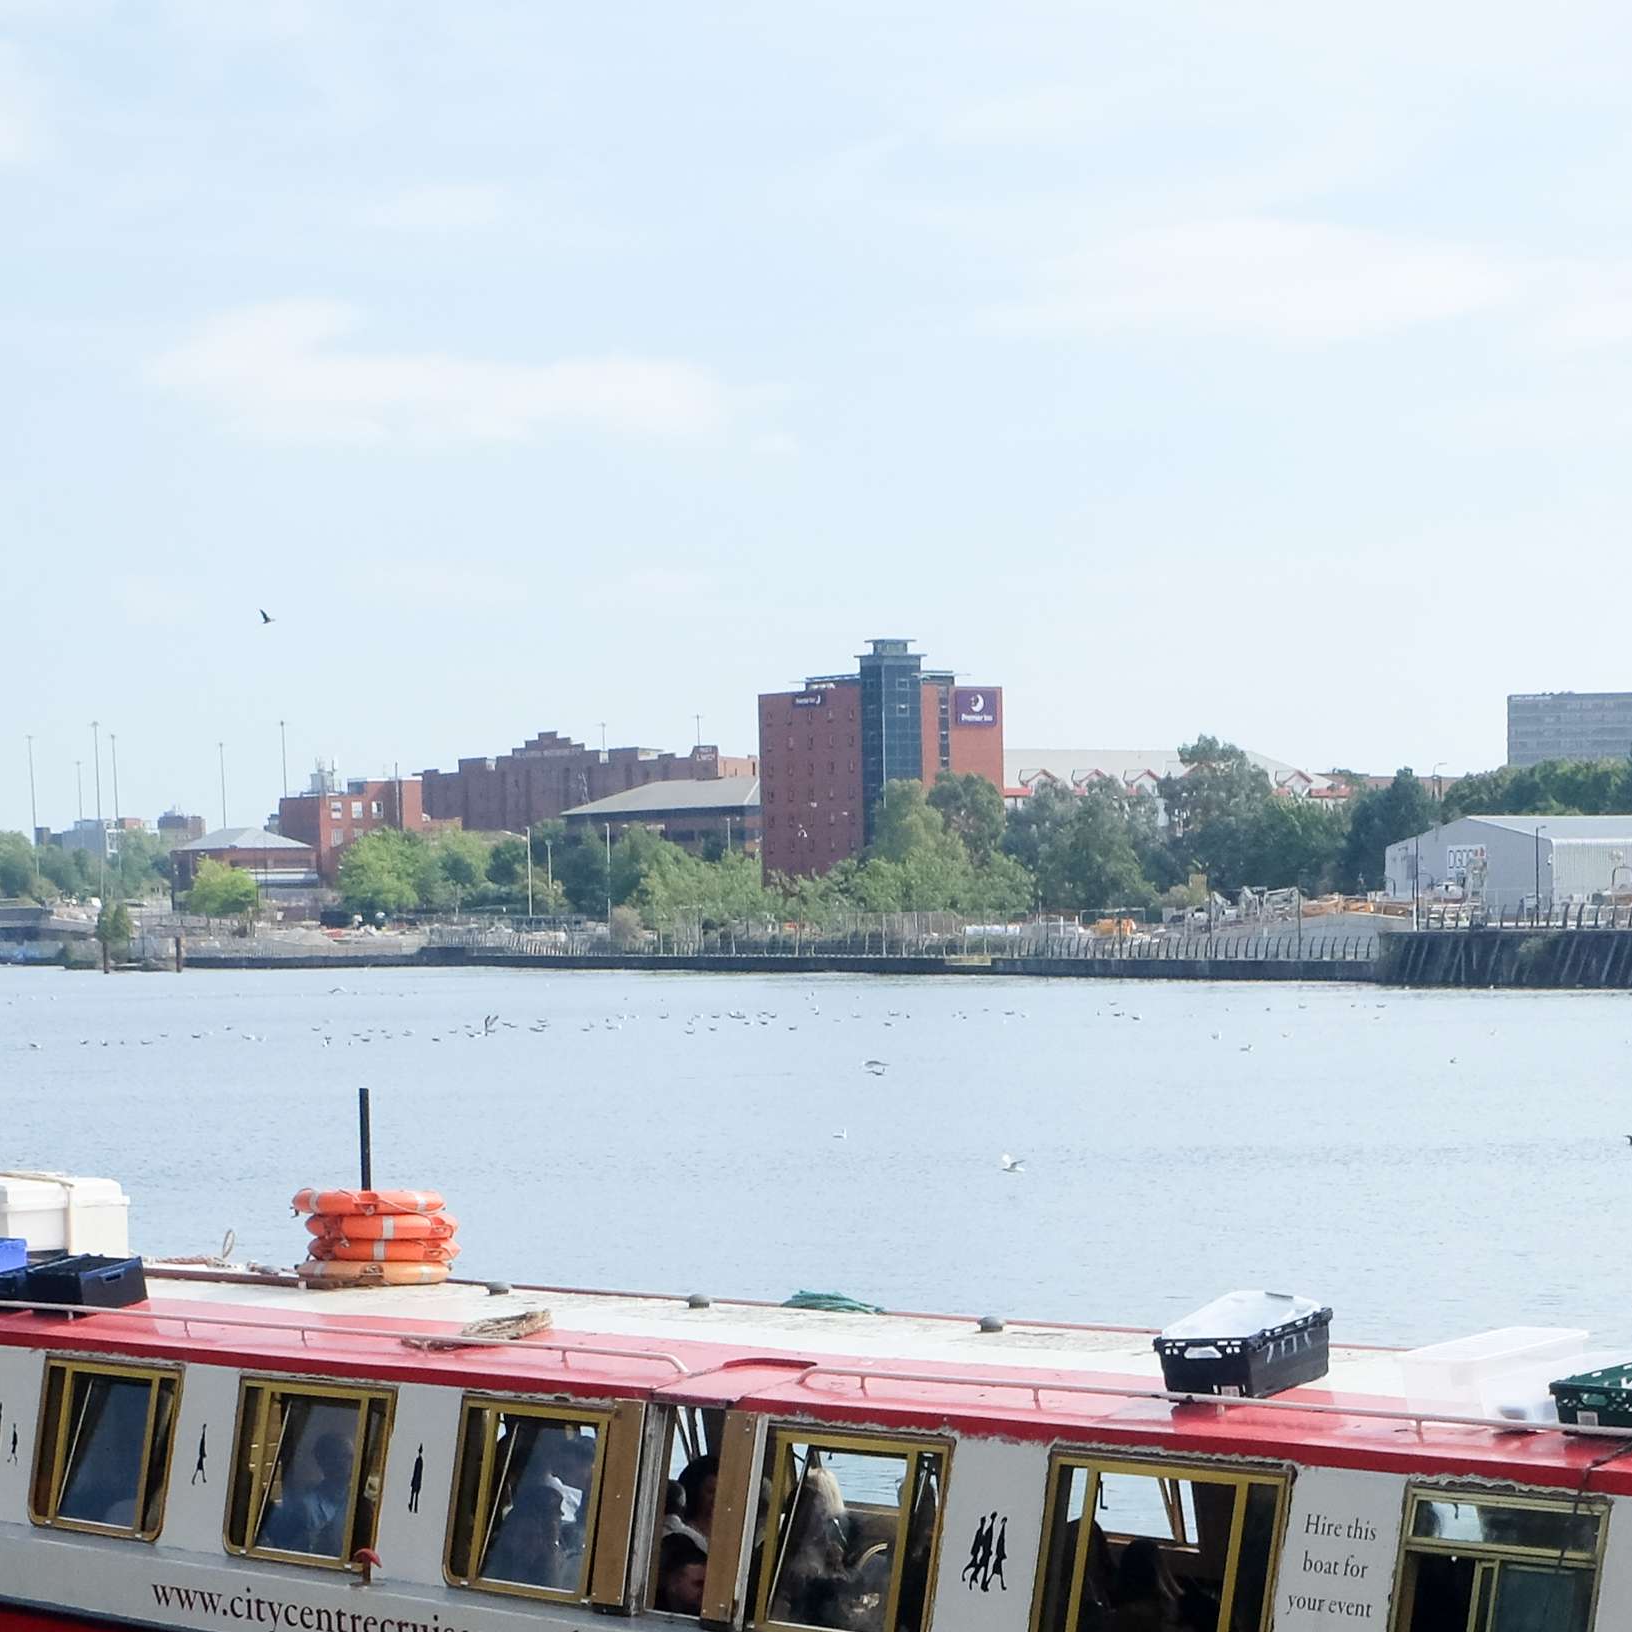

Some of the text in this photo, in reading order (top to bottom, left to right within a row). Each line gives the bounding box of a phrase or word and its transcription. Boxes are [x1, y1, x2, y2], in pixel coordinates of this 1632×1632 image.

[1304, 1513, 1377, 1541] Hire this
[1303, 1550, 1369, 1579] boat for
[1286, 1594, 1373, 1618] your event
